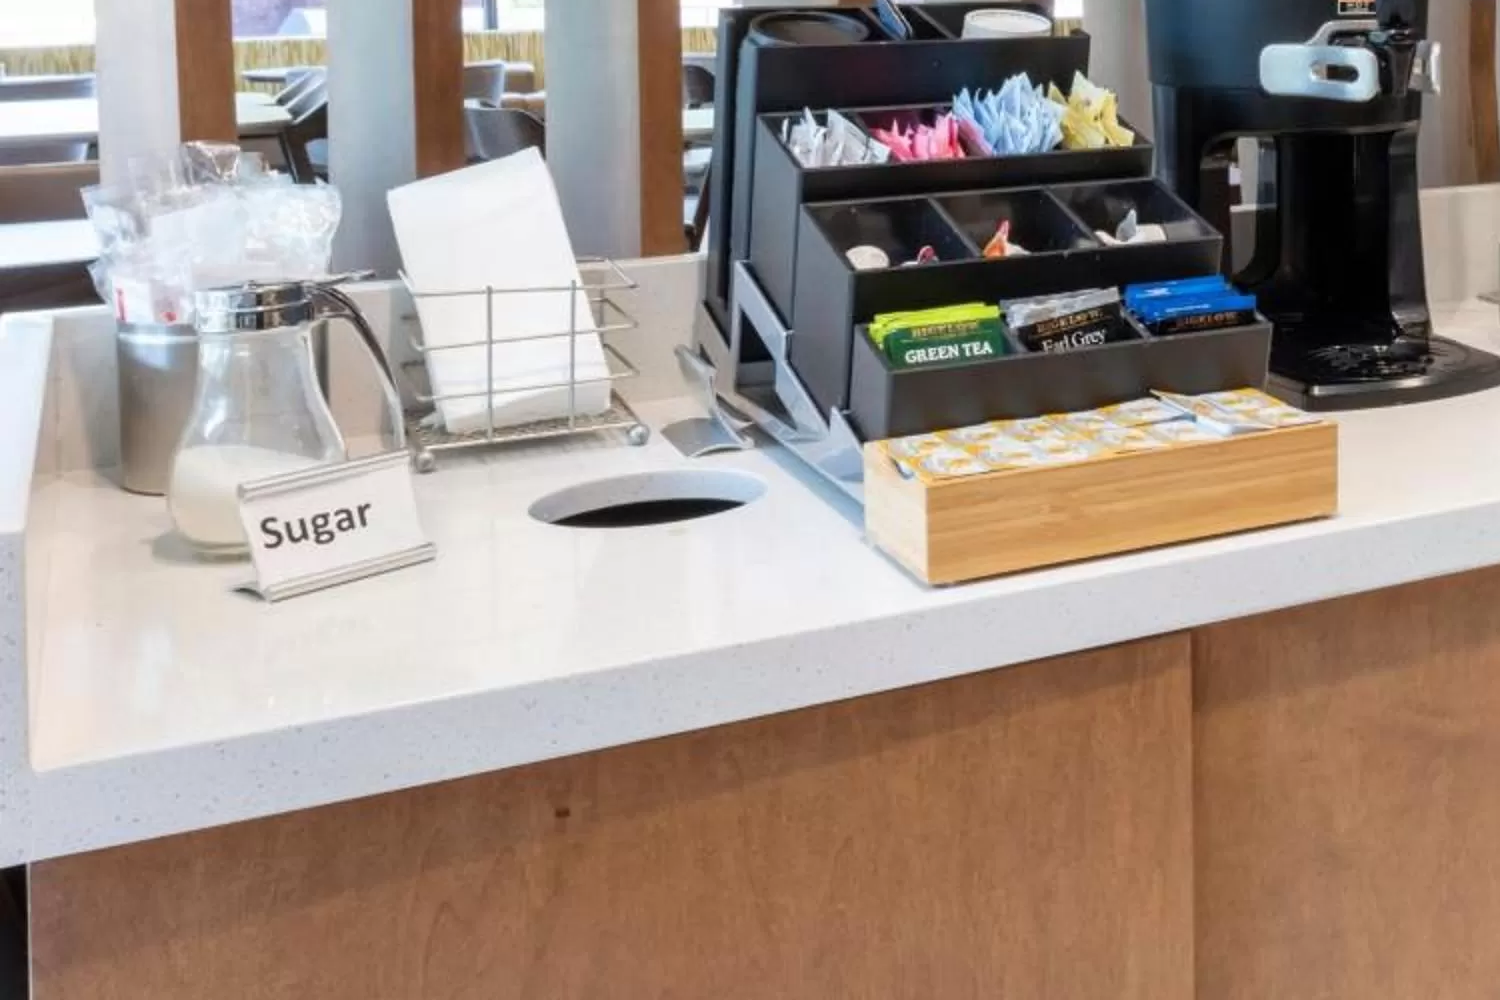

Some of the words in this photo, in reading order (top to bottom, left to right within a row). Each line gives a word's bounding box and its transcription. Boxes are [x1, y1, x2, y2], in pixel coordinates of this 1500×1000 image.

[1071, 329, 1106, 347] Grey
[904, 344, 960, 363] GREEN
[962, 341, 993, 357] TEA
[260, 502, 371, 549] Sugar
